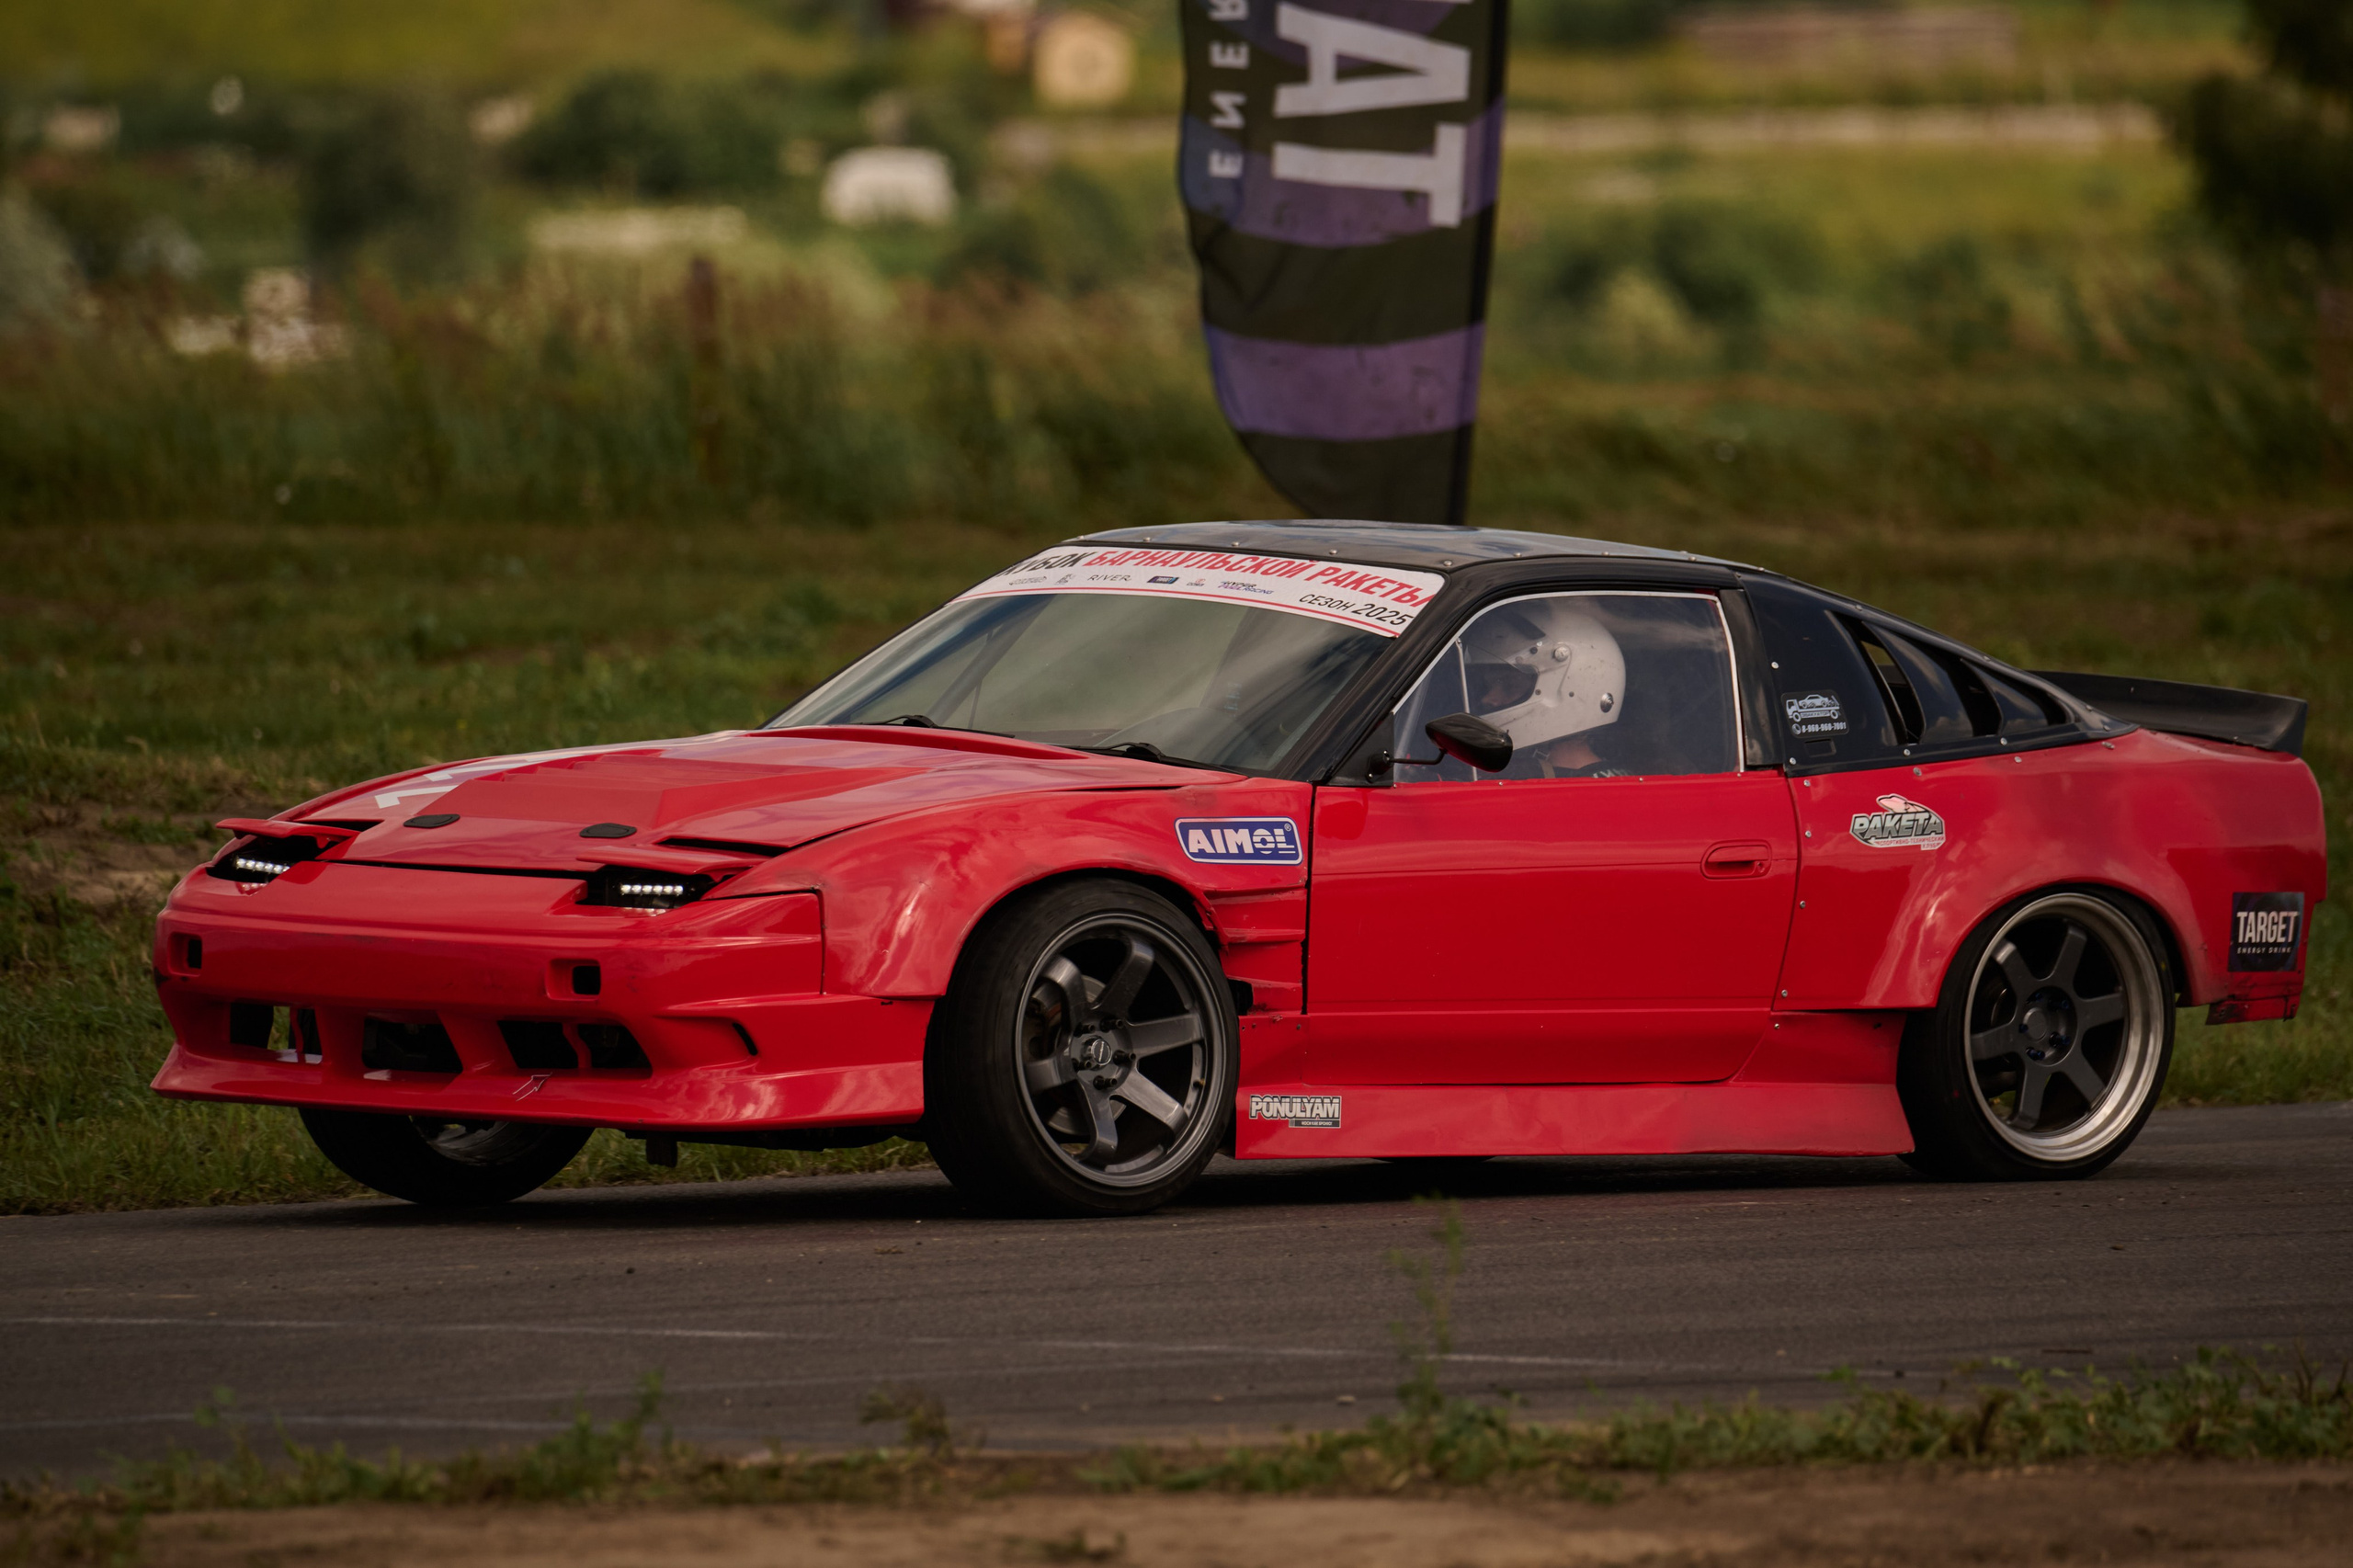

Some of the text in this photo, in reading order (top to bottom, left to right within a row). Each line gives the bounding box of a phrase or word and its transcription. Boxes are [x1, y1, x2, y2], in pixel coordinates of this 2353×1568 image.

[1082, 551, 1316, 578] БАРНАУЛЬСКОЙ
[1299, 594, 1414, 626] СЕЗОН 2025
[1852, 812, 1943, 840] РАКЕТА
[1188, 828, 1296, 854] AIMOL
[2236, 911, 2300, 943] TARGET
[1251, 1096, 1340, 1118] PONULYAM
